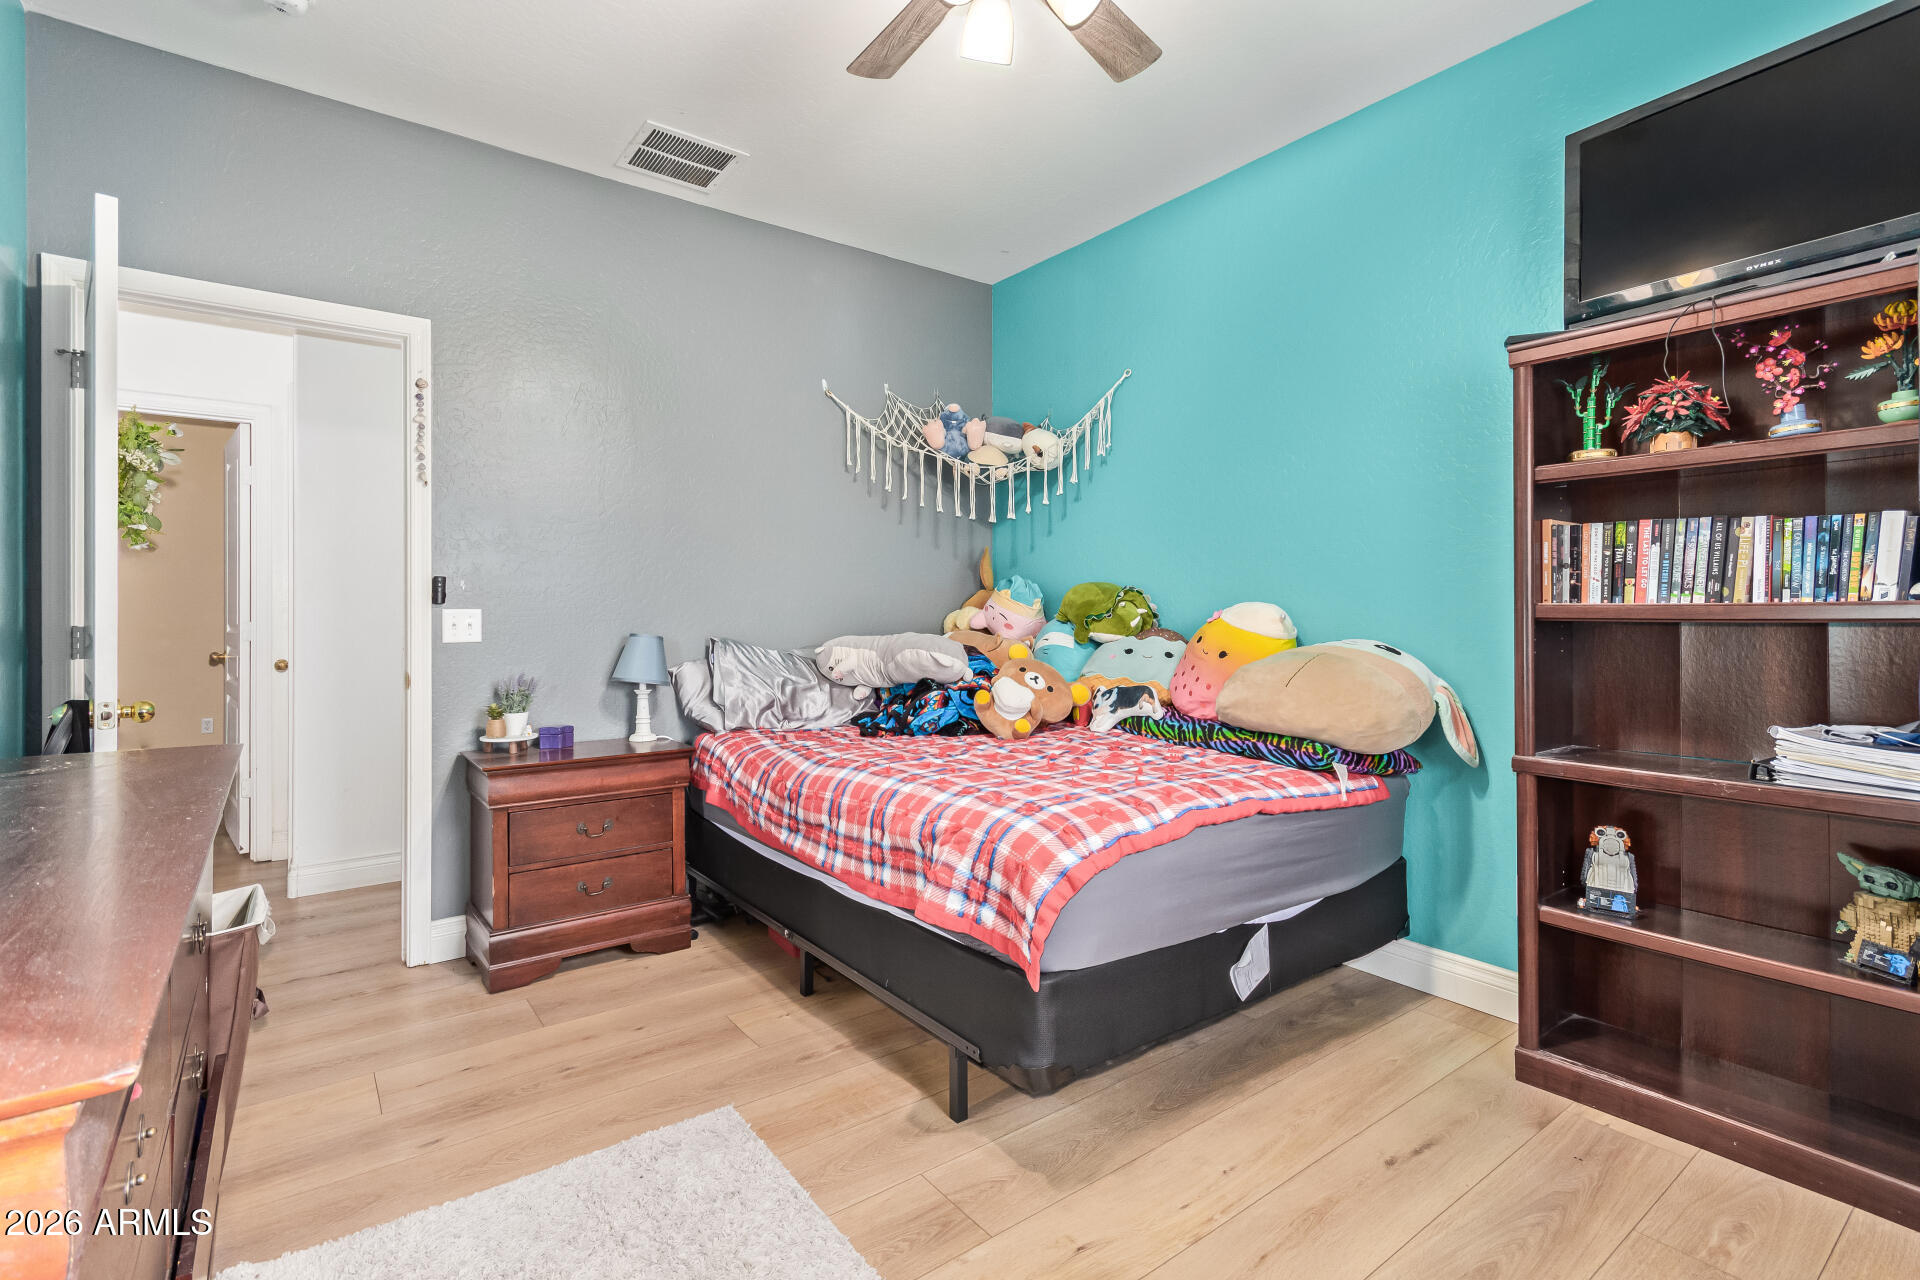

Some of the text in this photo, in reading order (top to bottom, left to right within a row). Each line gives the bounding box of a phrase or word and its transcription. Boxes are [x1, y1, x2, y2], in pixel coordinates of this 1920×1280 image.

[1745, 258, 1783, 271] DYNEX
[1715, 533, 1722, 541] OF
[1794, 533, 1802, 546] ONE
[1739, 538, 1752, 553] LIFE
[1642, 557, 1648, 565] TO
[1712, 552, 1720, 575] VILLAINS
[1738, 560, 1749, 568] PI
[1661, 560, 1669, 583] BUTCHER
[1792, 561, 1802, 588] SORROW
[1641, 579, 1647, 588] GO
[1683, 568, 1694, 589] TRIALS
